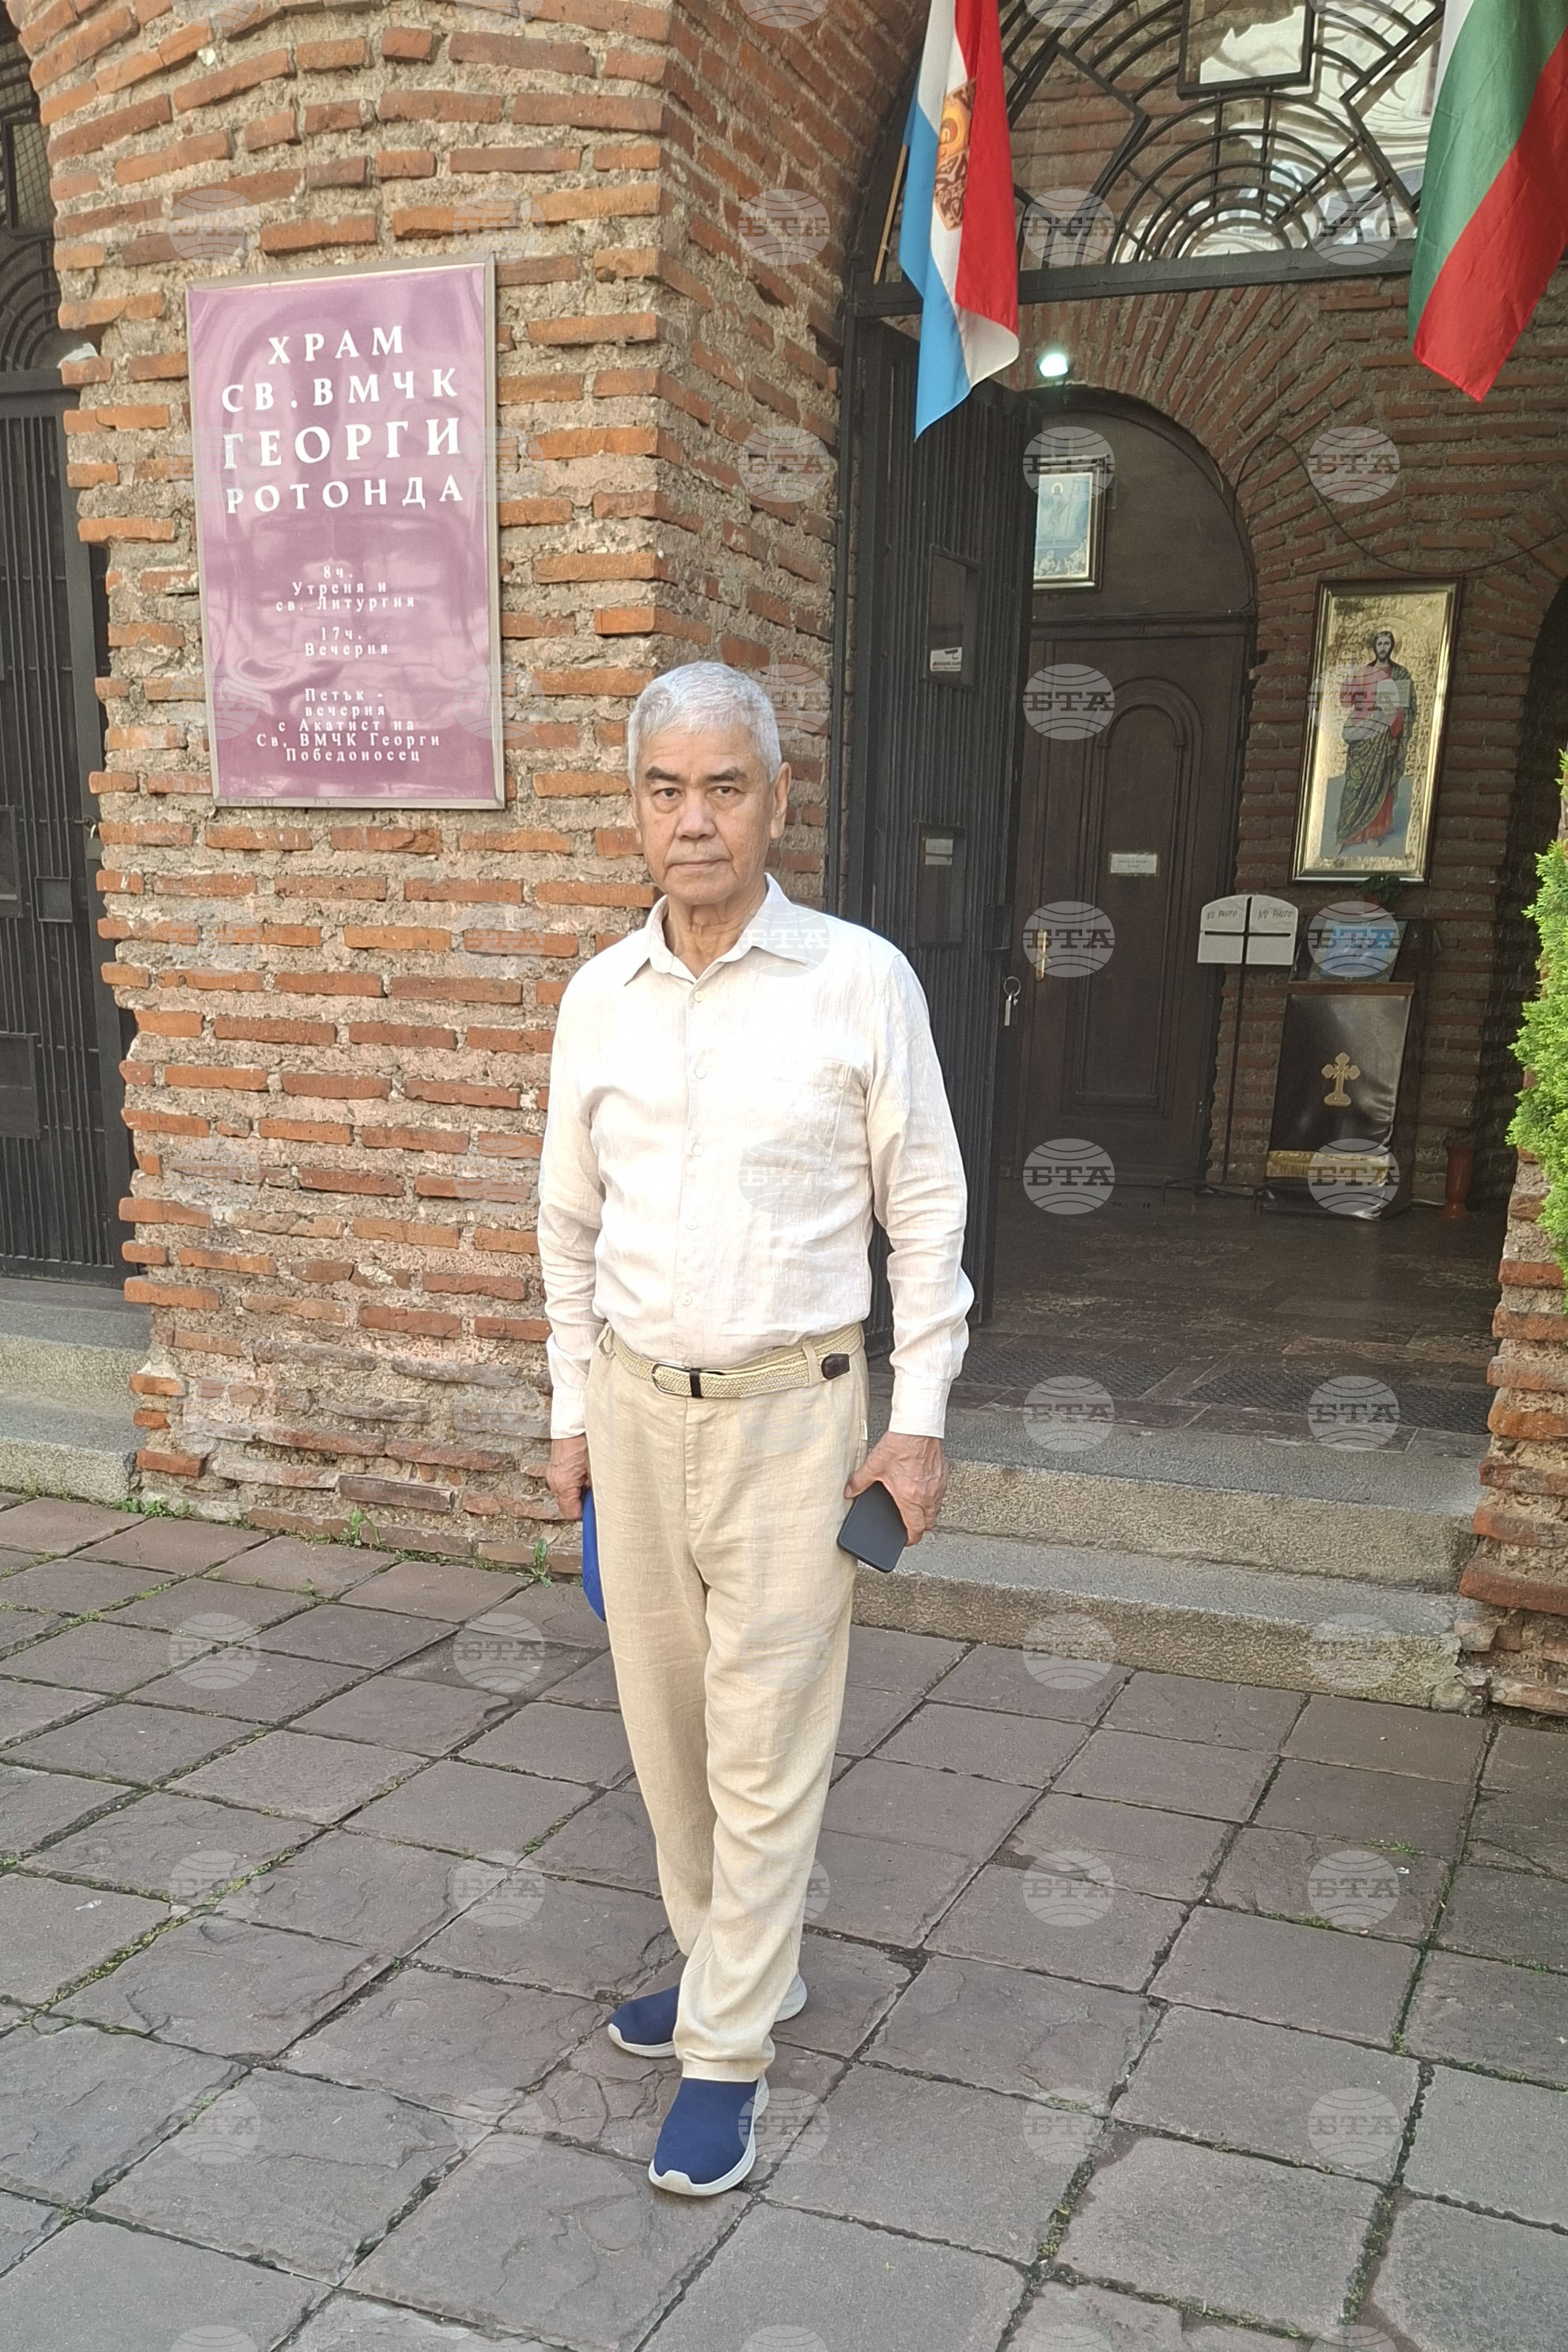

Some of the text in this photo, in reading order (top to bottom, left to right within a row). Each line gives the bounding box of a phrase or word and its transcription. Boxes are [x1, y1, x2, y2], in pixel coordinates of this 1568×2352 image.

[268, 326, 403, 364] ХРАМ
[223, 418, 461, 469] ГЕОРГИ
[226, 475, 463, 513] РОТОНДА
[292, 581, 364, 598] Утреня
[316, 596, 415, 612] Литургия
[305, 642, 388, 658] Вечерня
[305, 687, 364, 702] Петък
[305, 705, 385, 719] вечерня
[299, 718, 380, 732] Акатист
[393, 720, 415, 731] на
[300, 733, 357, 746] ВМЧК
[369, 733, 439, 749] Георги
[286, 748, 420, 762] Победоносец
